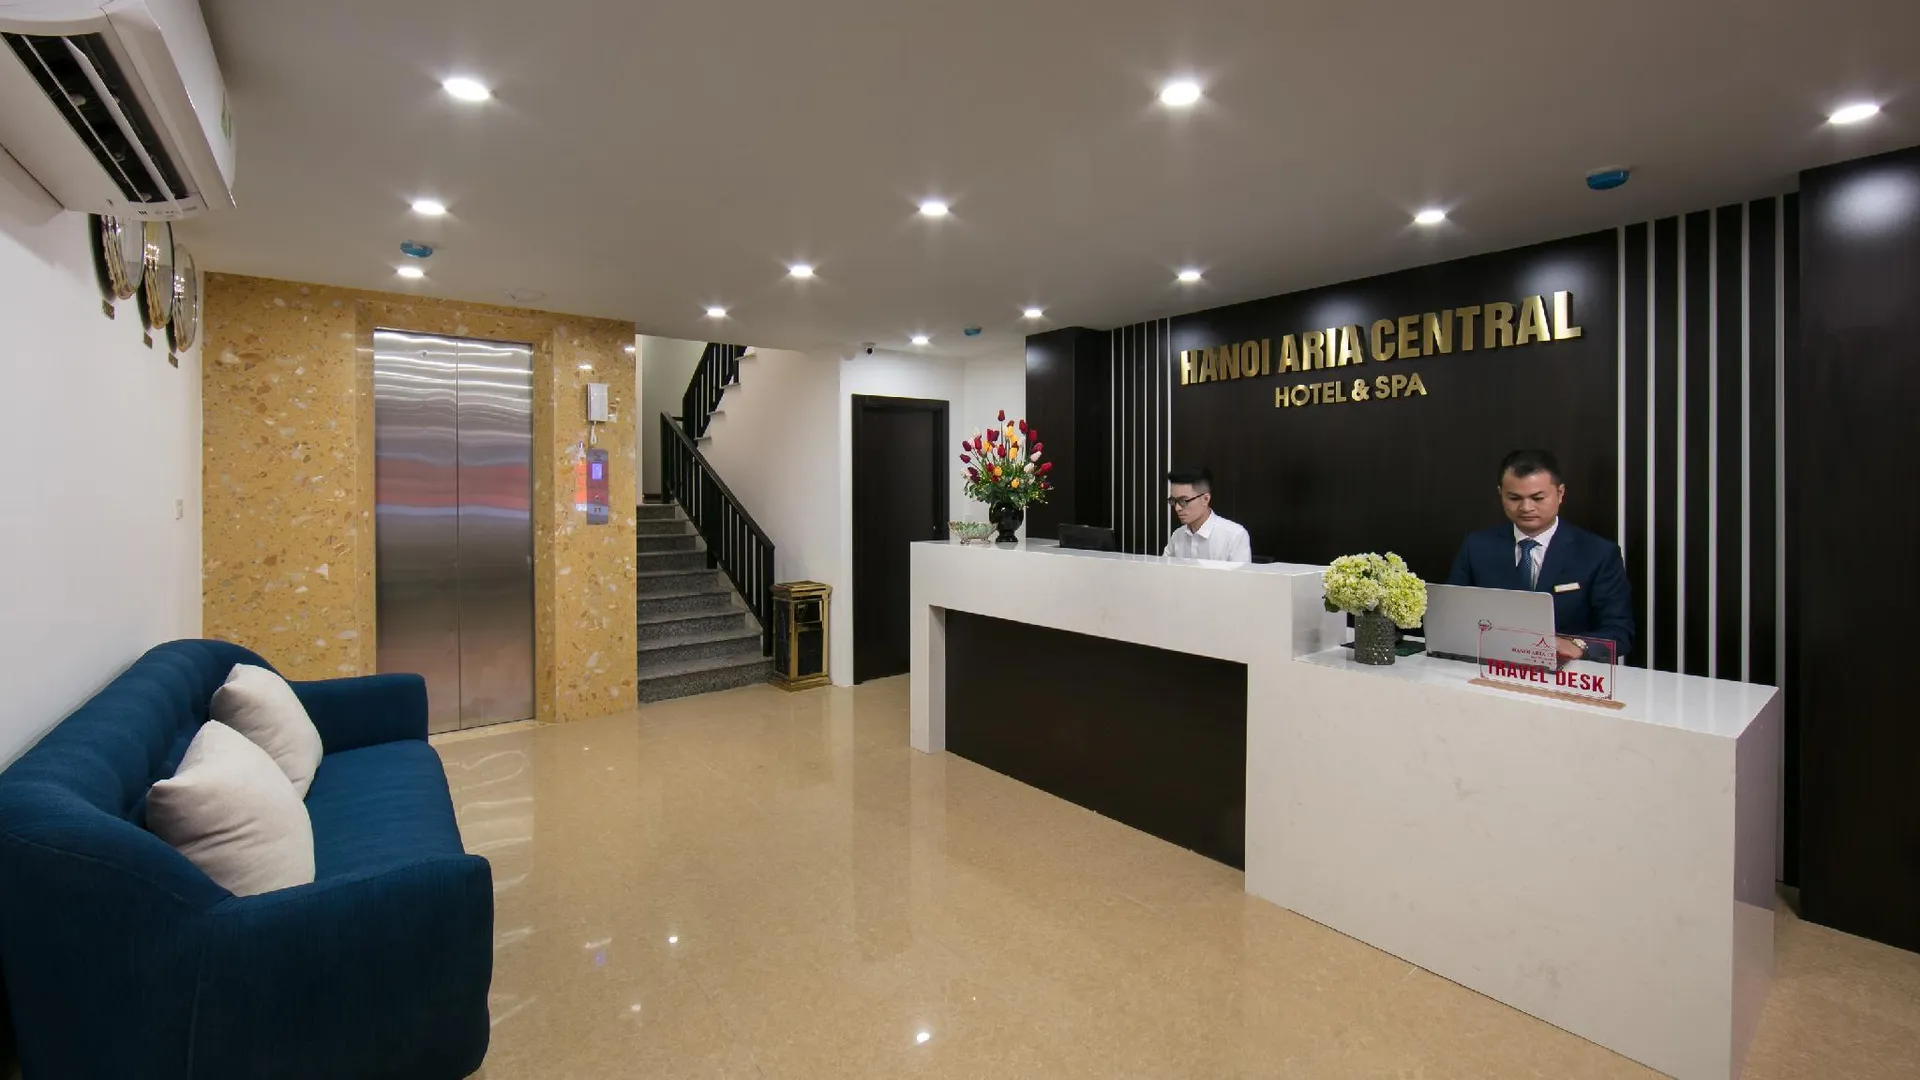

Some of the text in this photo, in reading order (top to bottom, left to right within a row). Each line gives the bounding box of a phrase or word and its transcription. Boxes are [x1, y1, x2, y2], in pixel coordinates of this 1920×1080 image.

[1180, 289, 1582, 386] HANOI ARIA CENTRAL
[1275, 372, 1428, 408] HOTEL & SPA
[1486, 658, 1605, 694] TRAVEL DESK
